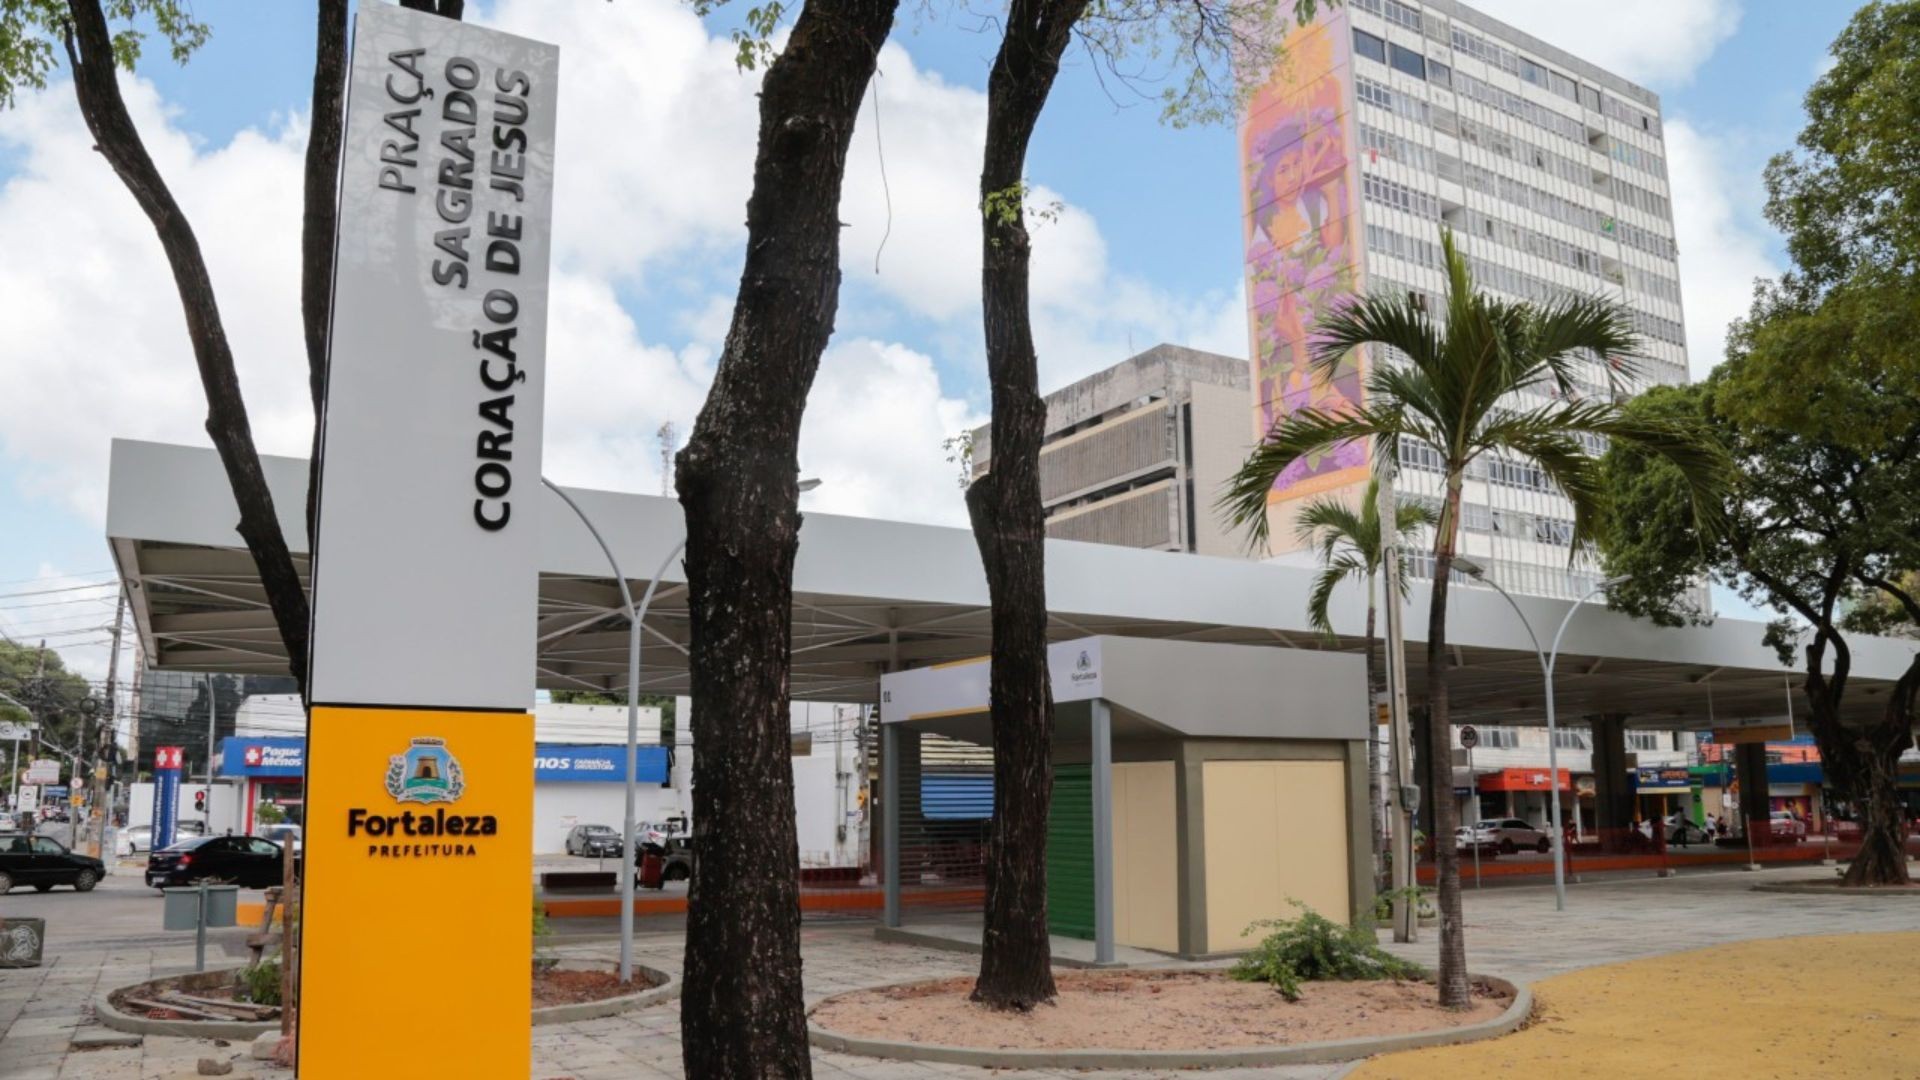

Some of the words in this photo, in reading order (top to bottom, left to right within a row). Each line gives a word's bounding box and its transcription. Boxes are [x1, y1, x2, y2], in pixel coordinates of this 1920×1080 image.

[379, 48, 434, 194] PRAÇA
[490, 67, 530, 202] JESUS
[432, 56, 480, 289] SAGRADO
[485, 211, 523, 275] DE
[473, 289, 526, 532] CORAÇÃO
[261, 757, 302, 767] Menos
[262, 746, 301, 758] Pague
[534, 758, 570, 769] nos
[348, 808, 497, 838] Fortaleza
[368, 844, 476, 858] PREFEITURA
